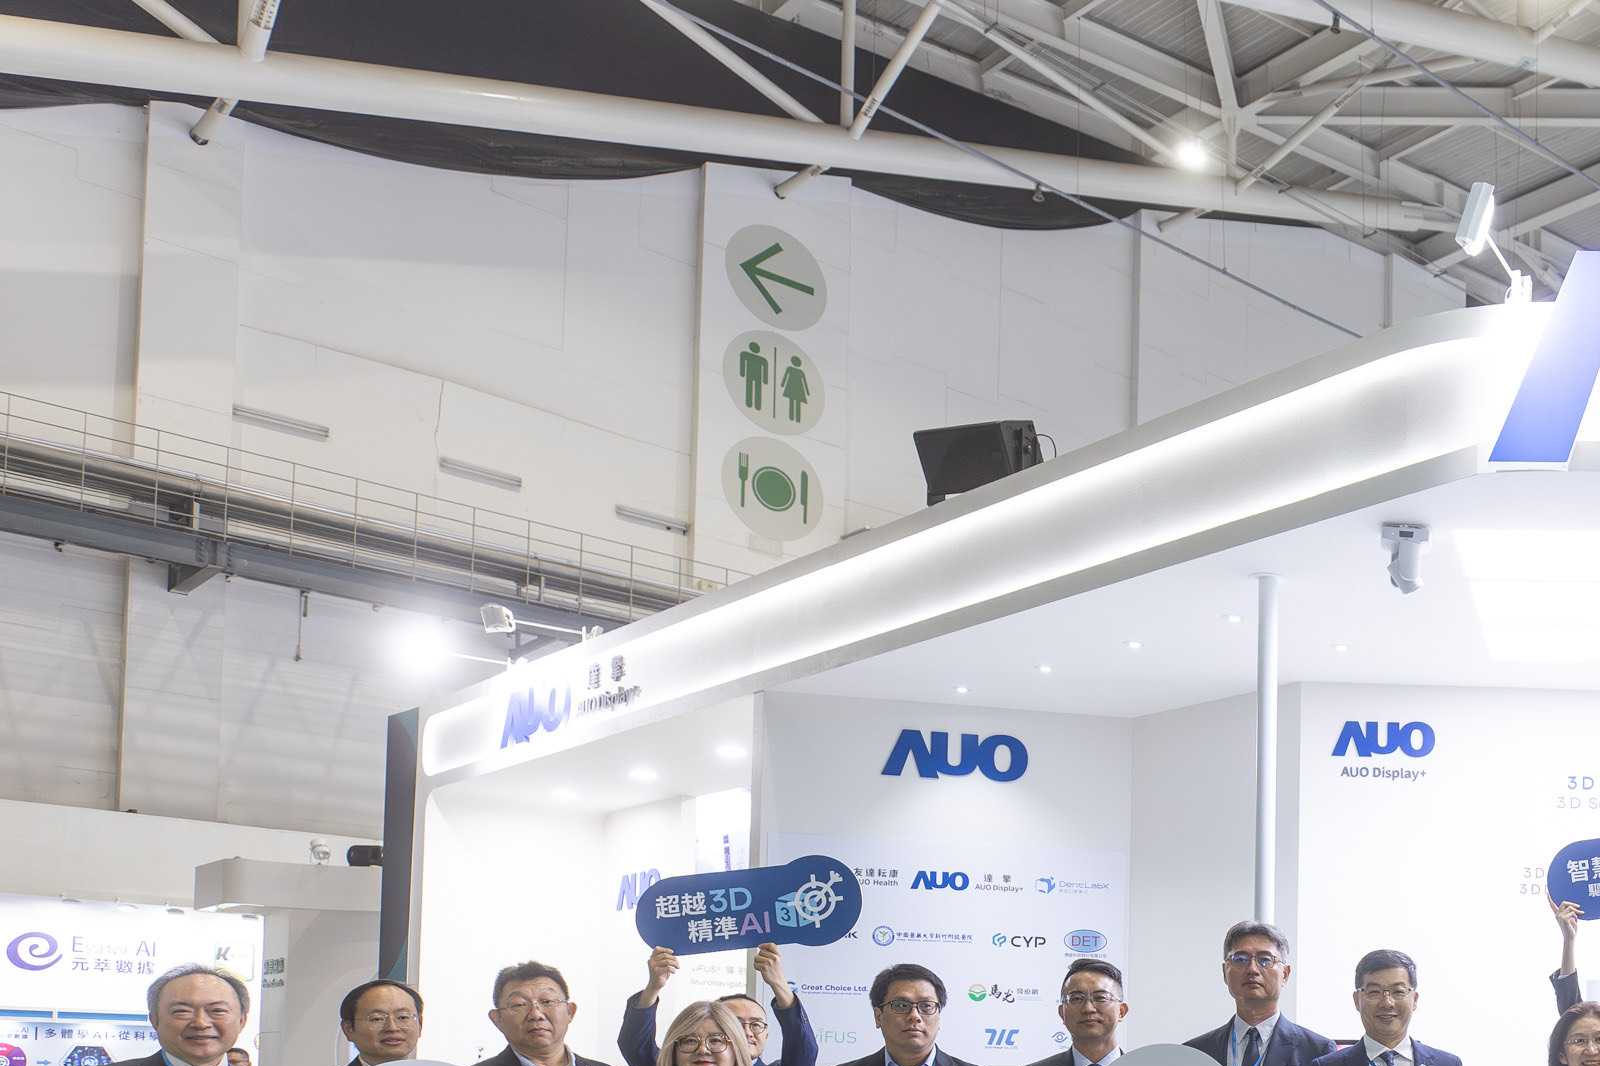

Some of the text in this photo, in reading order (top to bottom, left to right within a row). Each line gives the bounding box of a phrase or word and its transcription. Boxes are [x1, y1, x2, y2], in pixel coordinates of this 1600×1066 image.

[1331, 720, 1436, 758] AUO
[881, 729, 1029, 782] AUO
[1340, 766, 1427, 781] AUO Display+
[1557, 796, 1581, 809] 3D
[873, 879, 899, 887] Health
[910, 870, 970, 891] AUO
[993, 884, 1023, 894] Display+
[1011, 935, 1046, 948] CYP
[1071, 935, 1101, 947] DET
[136, 941, 156, 957] AI
